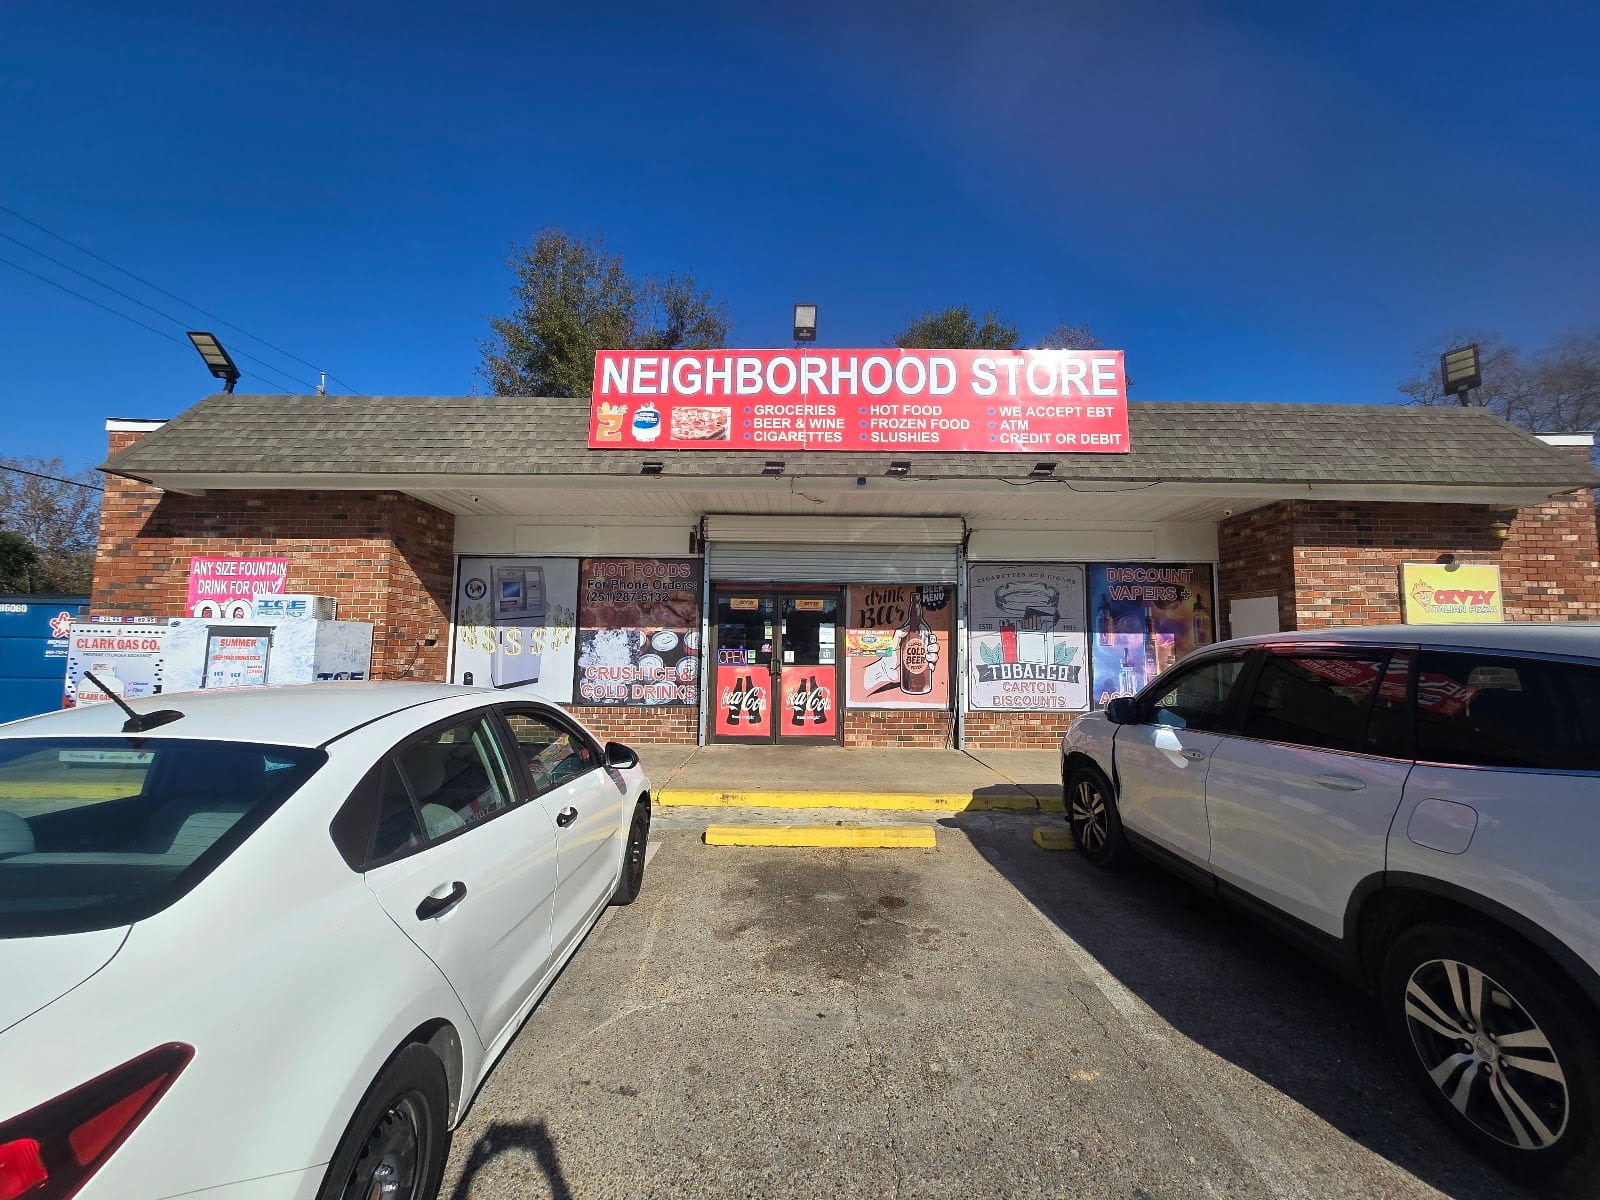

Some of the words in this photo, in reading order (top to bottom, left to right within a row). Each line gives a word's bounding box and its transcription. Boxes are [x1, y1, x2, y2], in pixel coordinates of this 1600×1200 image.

[601, 356, 957, 396] NEIGHBORHOOD
[970, 357, 1119, 397] STORE
[754, 404, 836, 416] GROCERIES
[870, 405, 900, 416] HOT
[903, 405, 942, 417] FOOD
[999, 406, 1022, 417] WE
[1026, 406, 1083, 417] ACCEPT
[1086, 407, 1114, 418] EBT
[753, 417, 791, 429] BEER
[795, 418, 806, 429] &
[809, 418, 845, 429] WINE
[870, 418, 929, 430] FROZEN
[930, 418, 970, 430] FOOD
[1000, 419, 1029, 431] ATM
[753, 430, 843, 443] CIGARETTES
[870, 431, 940, 443] SLUSHIES
[1000, 433, 1052, 445] CREDIT
[1055, 433, 1077, 445] OR
[1080, 434, 1122, 445] DEBIT
[193, 561, 214, 575] ANY
[215, 561, 237, 576] SIZE
[238, 561, 287, 577] FOUNTAIN
[593, 563, 629, 577] HOT
[633, 563, 691, 578] FOODS
[1106, 567, 1194, 583] DISCOUNT
[977, 572, 1026, 584] CIGARETTES
[1047, 574, 1076, 585] CIGARS
[197, 580, 228, 594] DRINK
[229, 580, 250, 595] FOR
[587, 579, 607, 590] For
[610, 579, 650, 590] Phone
[652, 580, 698, 591] Orders:
[922, 585, 944, 594] BEER
[586, 592, 669, 604] (251)287-6132
[865, 587, 905, 606] drink
[922, 592, 945, 603] MENU
[1109, 586, 1178, 600] VAPERS
[258, 600, 306, 609] ICE
[1430, 605, 1467, 614] ITALIAN
[1469, 605, 1497, 614] PIZZA
[76, 638, 116, 650] CLARK
[117, 639, 139, 651] GAS
[141, 639, 160, 651] CO.
[219, 638, 257, 648] SUMMER
[719, 650, 747, 664] OPEN
[906, 647, 926, 656] COLD
[906, 656, 926, 665] BEER
[584, 666, 644, 682] CRUSH
[648, 667, 677, 682] ICE
[679, 667, 693, 682] &
[988, 664, 1070, 682] TOBACCO
[580, 684, 628, 700] COLD
[632, 685, 697, 700] DRINKS
[1002, 681, 1056, 694] CARTON
[78, 692, 99, 700] CLARK
[992, 695, 1067, 708] DISCOUNTS
